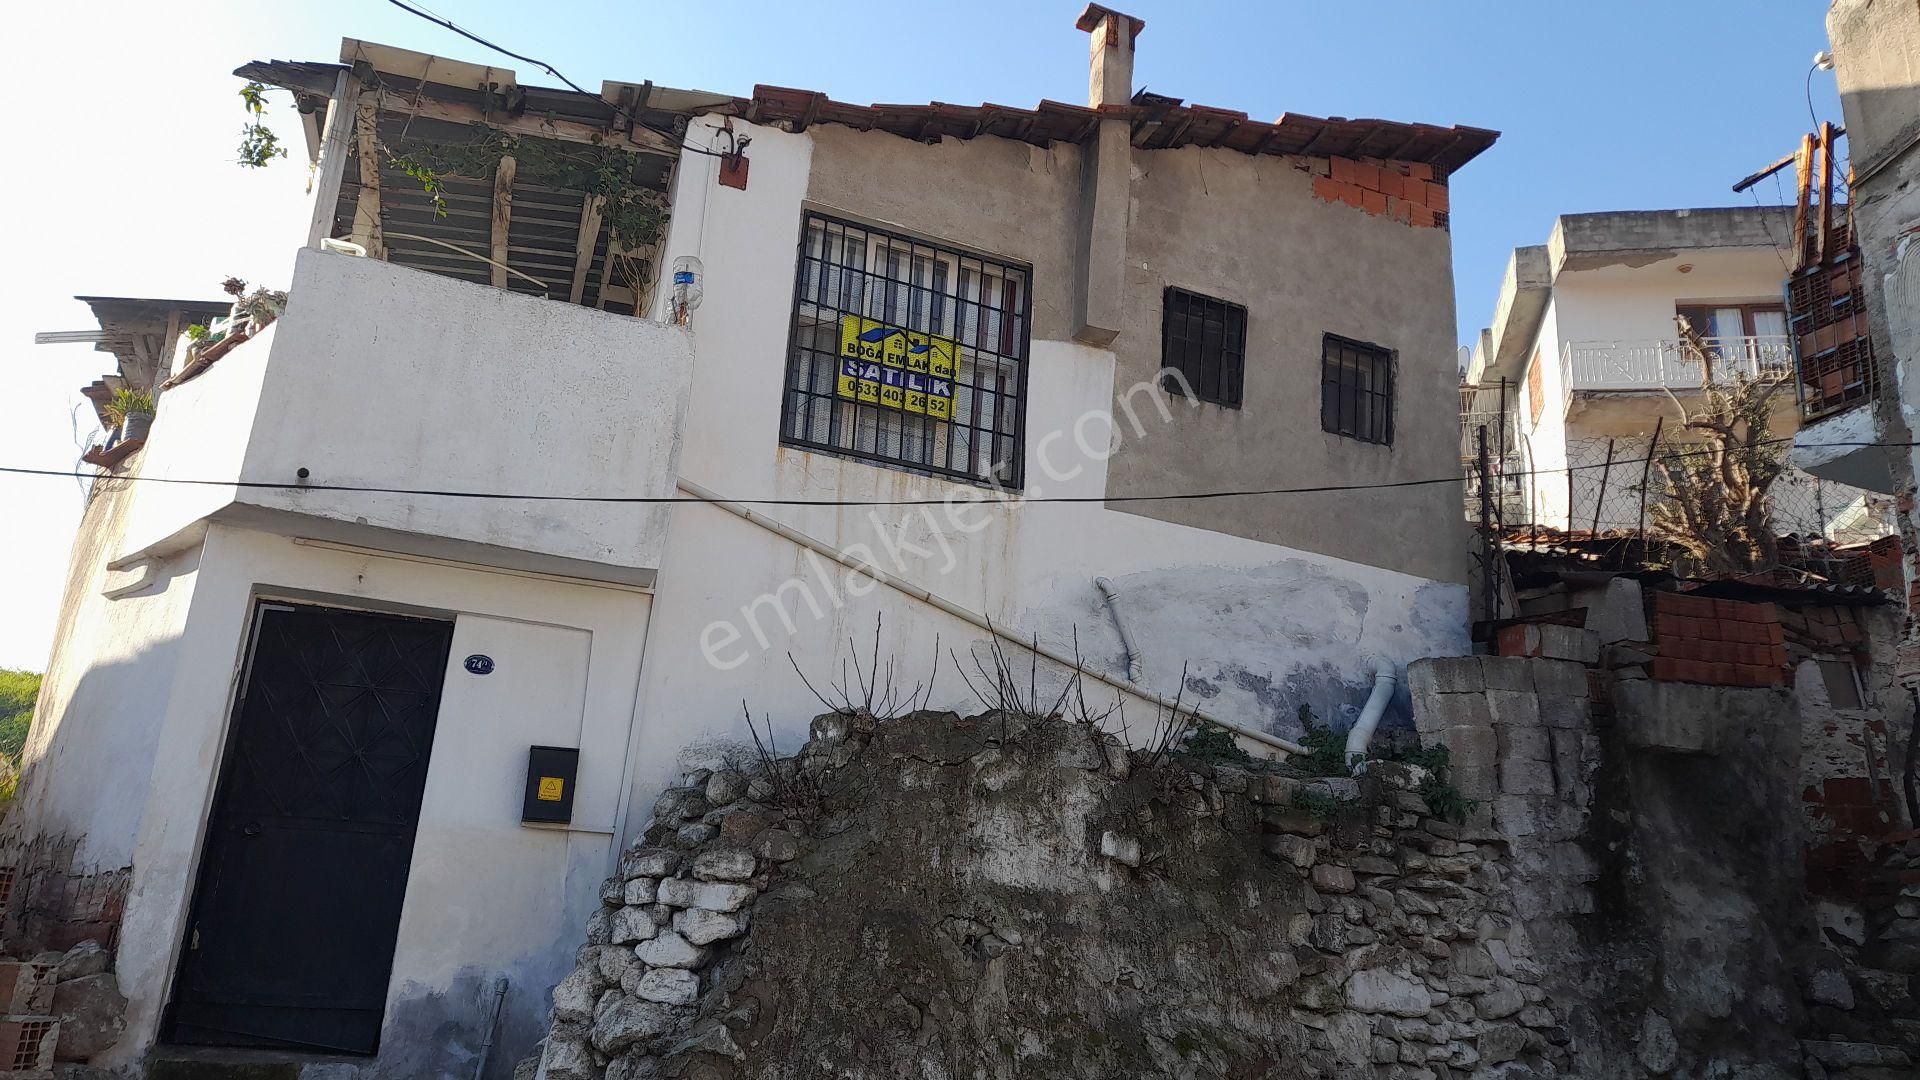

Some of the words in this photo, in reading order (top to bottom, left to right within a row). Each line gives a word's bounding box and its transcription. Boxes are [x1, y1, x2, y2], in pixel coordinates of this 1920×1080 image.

[847, 342, 884, 359] BOĞA
[887, 352, 930, 371] EMLAK
[847, 360, 951, 397] SATILIK
[848, 380, 880, 397] 0533
[910, 394, 928, 408] 26
[930, 399, 945, 412] 52
